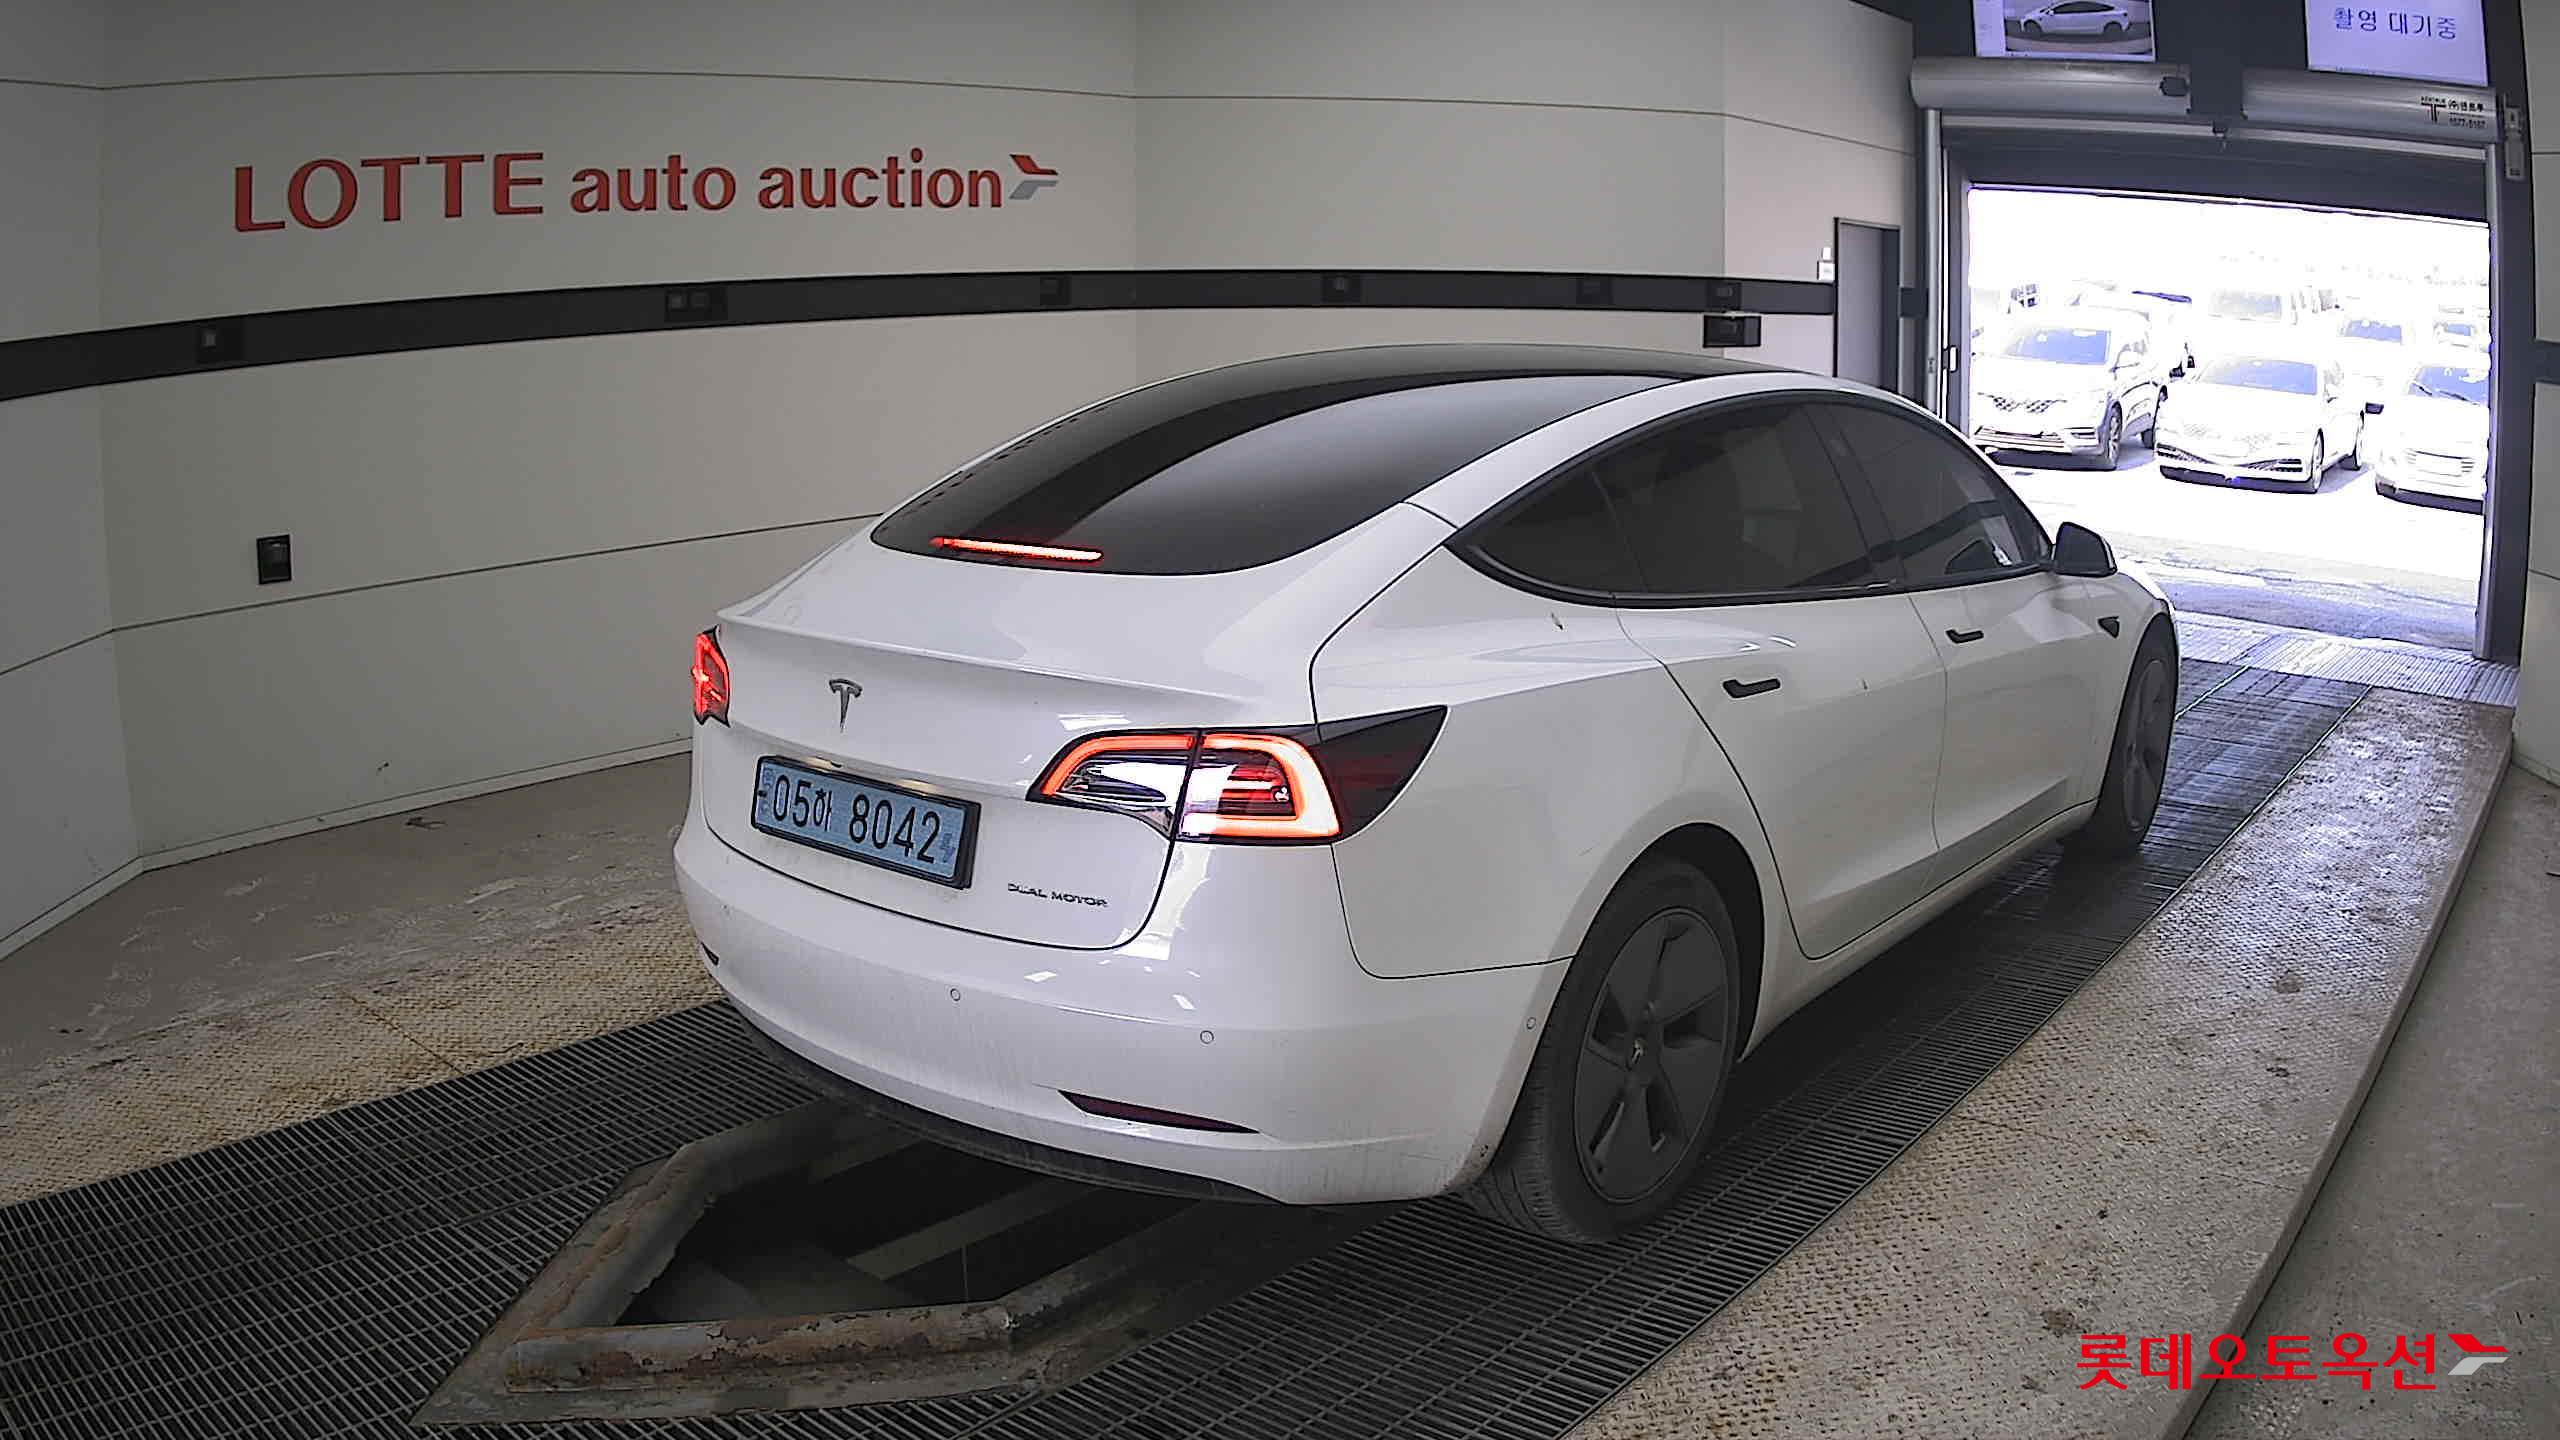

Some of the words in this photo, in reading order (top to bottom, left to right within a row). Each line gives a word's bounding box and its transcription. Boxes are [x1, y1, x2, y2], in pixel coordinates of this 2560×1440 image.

[2389, 12, 2456, 40] 대기중
[234, 151, 544, 233] LOTTE
[570, 154, 737, 214] auto
[757, 148, 1003, 210] auction
[773, 774, 833, 833] 05하
[849, 794, 942, 865] 8042
[1008, 883, 1047, 899] DUAL
[1051, 891, 1108, 908] MOTOR
